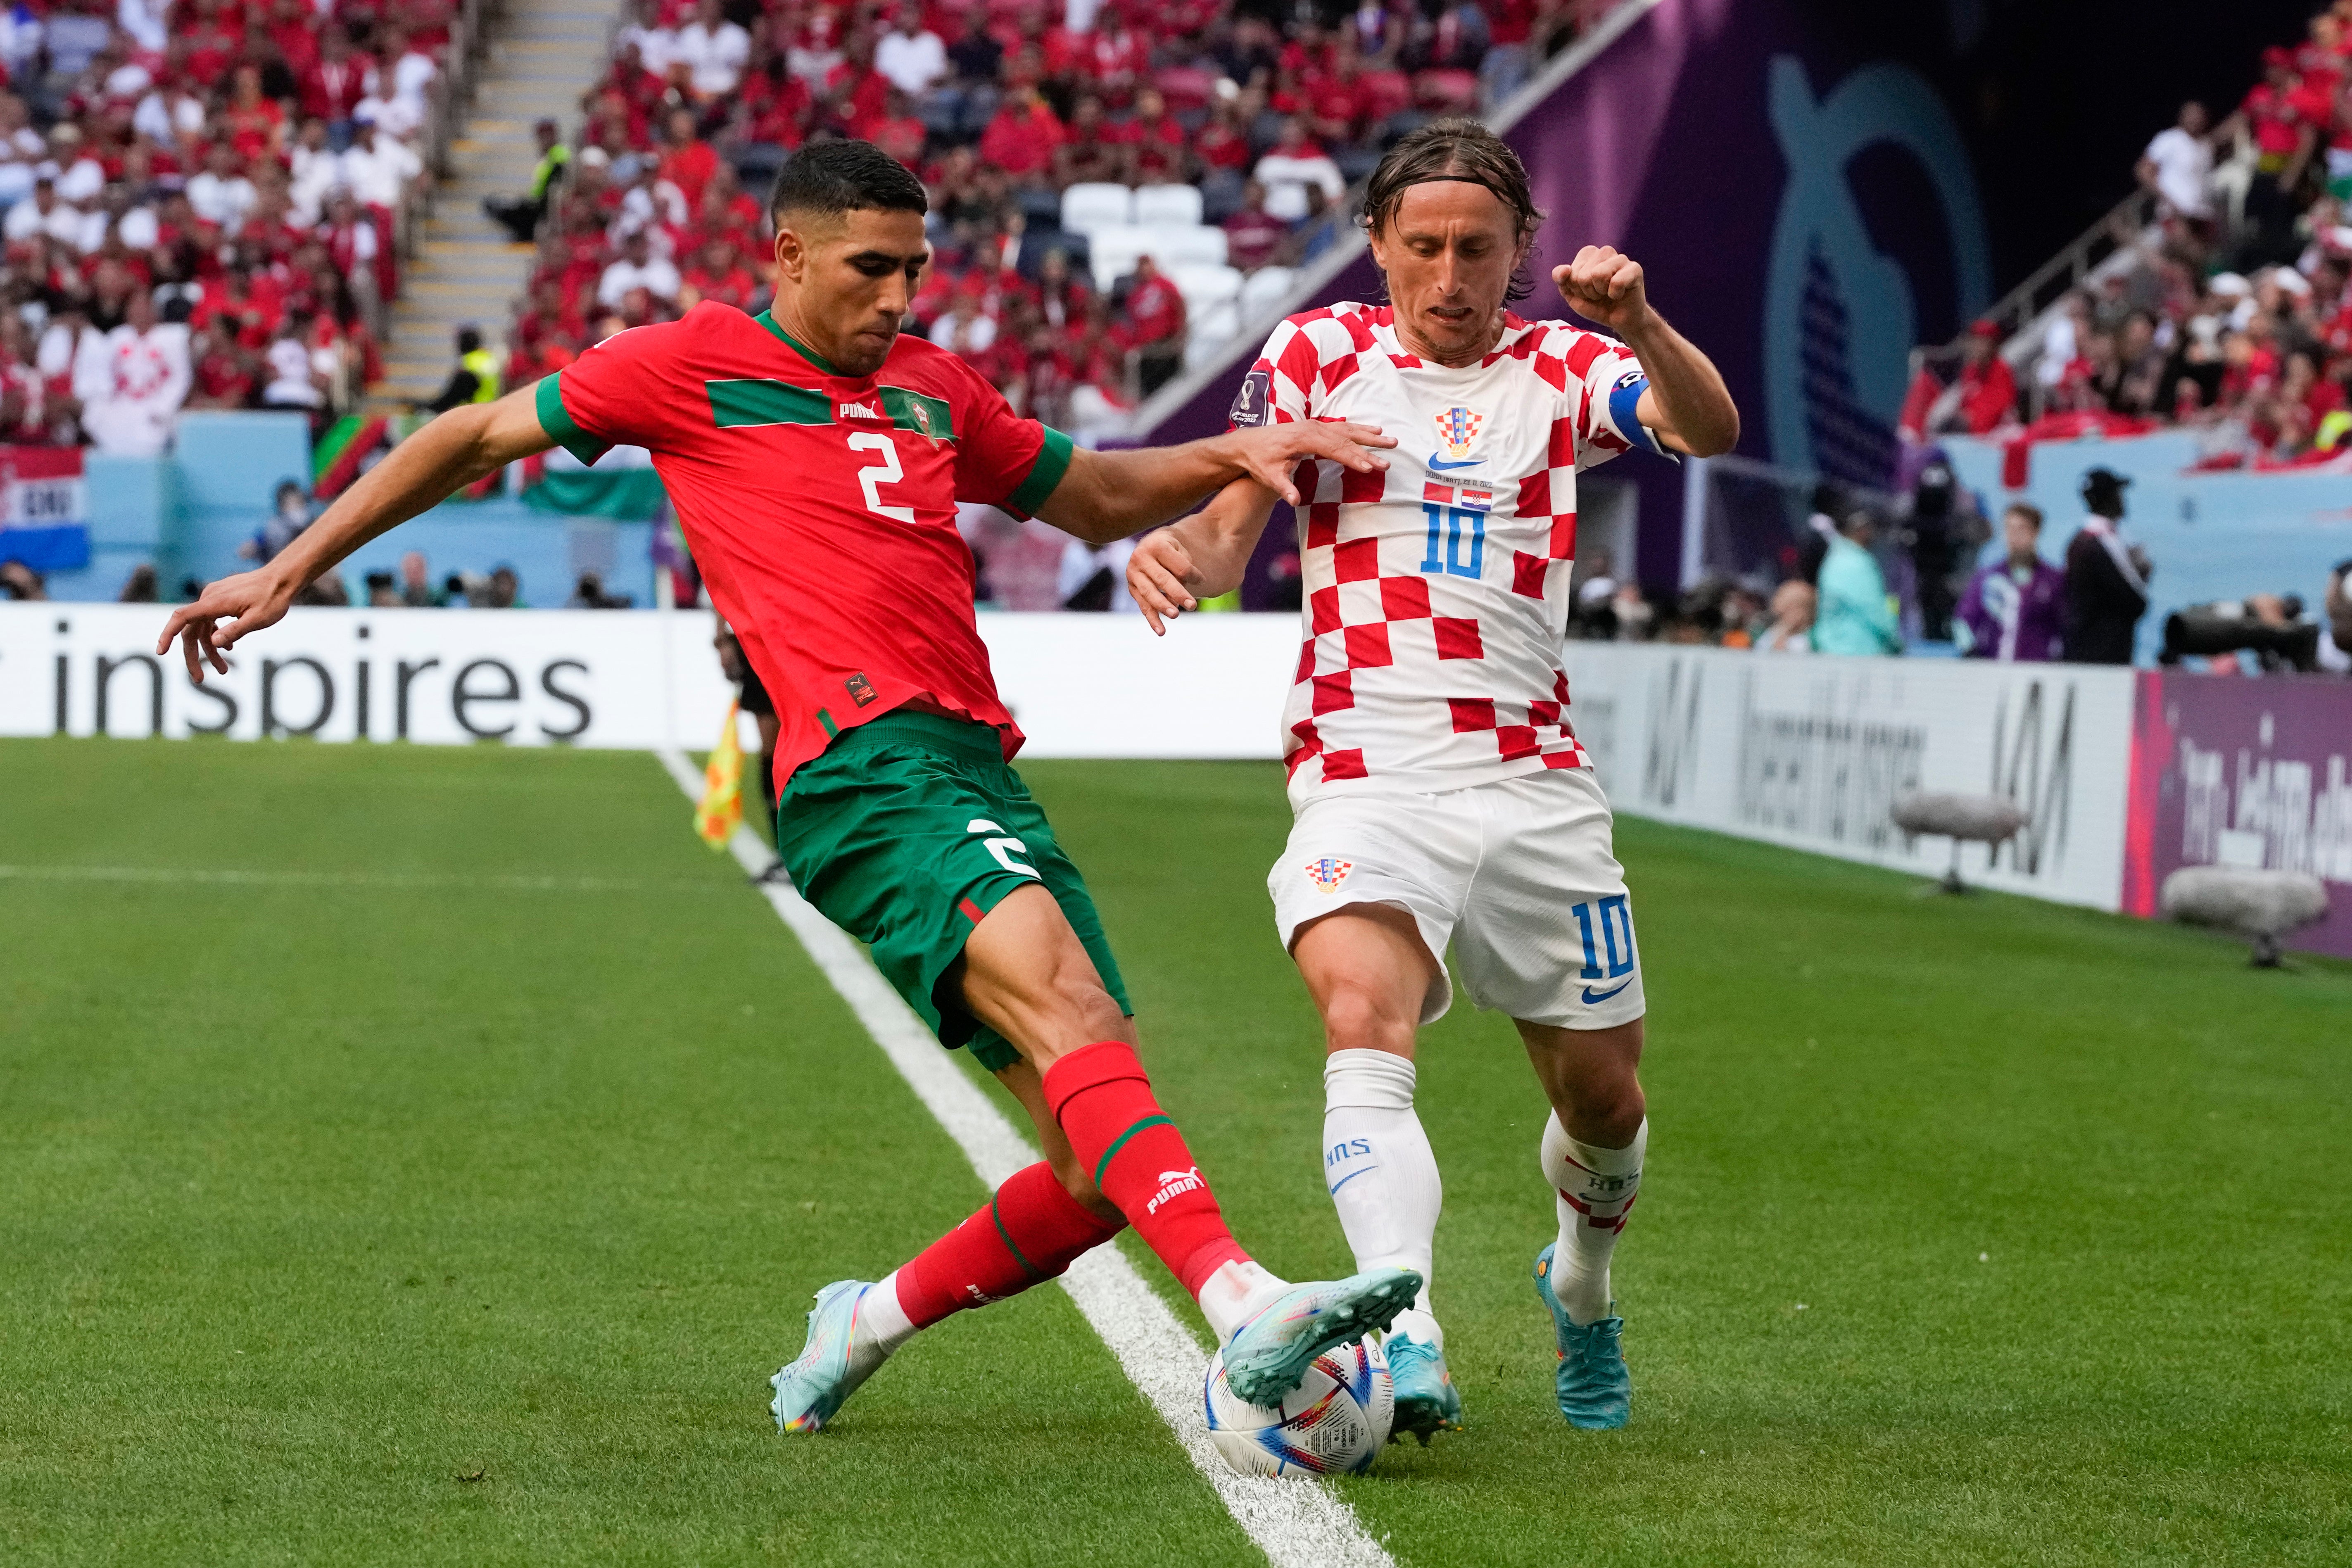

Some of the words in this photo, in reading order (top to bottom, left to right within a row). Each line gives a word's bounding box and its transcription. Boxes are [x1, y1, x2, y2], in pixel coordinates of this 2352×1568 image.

[847, 432, 917, 524] 2
[1425, 470, 1442, 480] DOHA
[1421, 503, 1485, 580] 10
[55, 621, 591, 742] inspires
[967, 819, 1042, 881] 2
[1572, 894, 1634, 979] 10
[1147, 1178, 1197, 1215] PUMA
